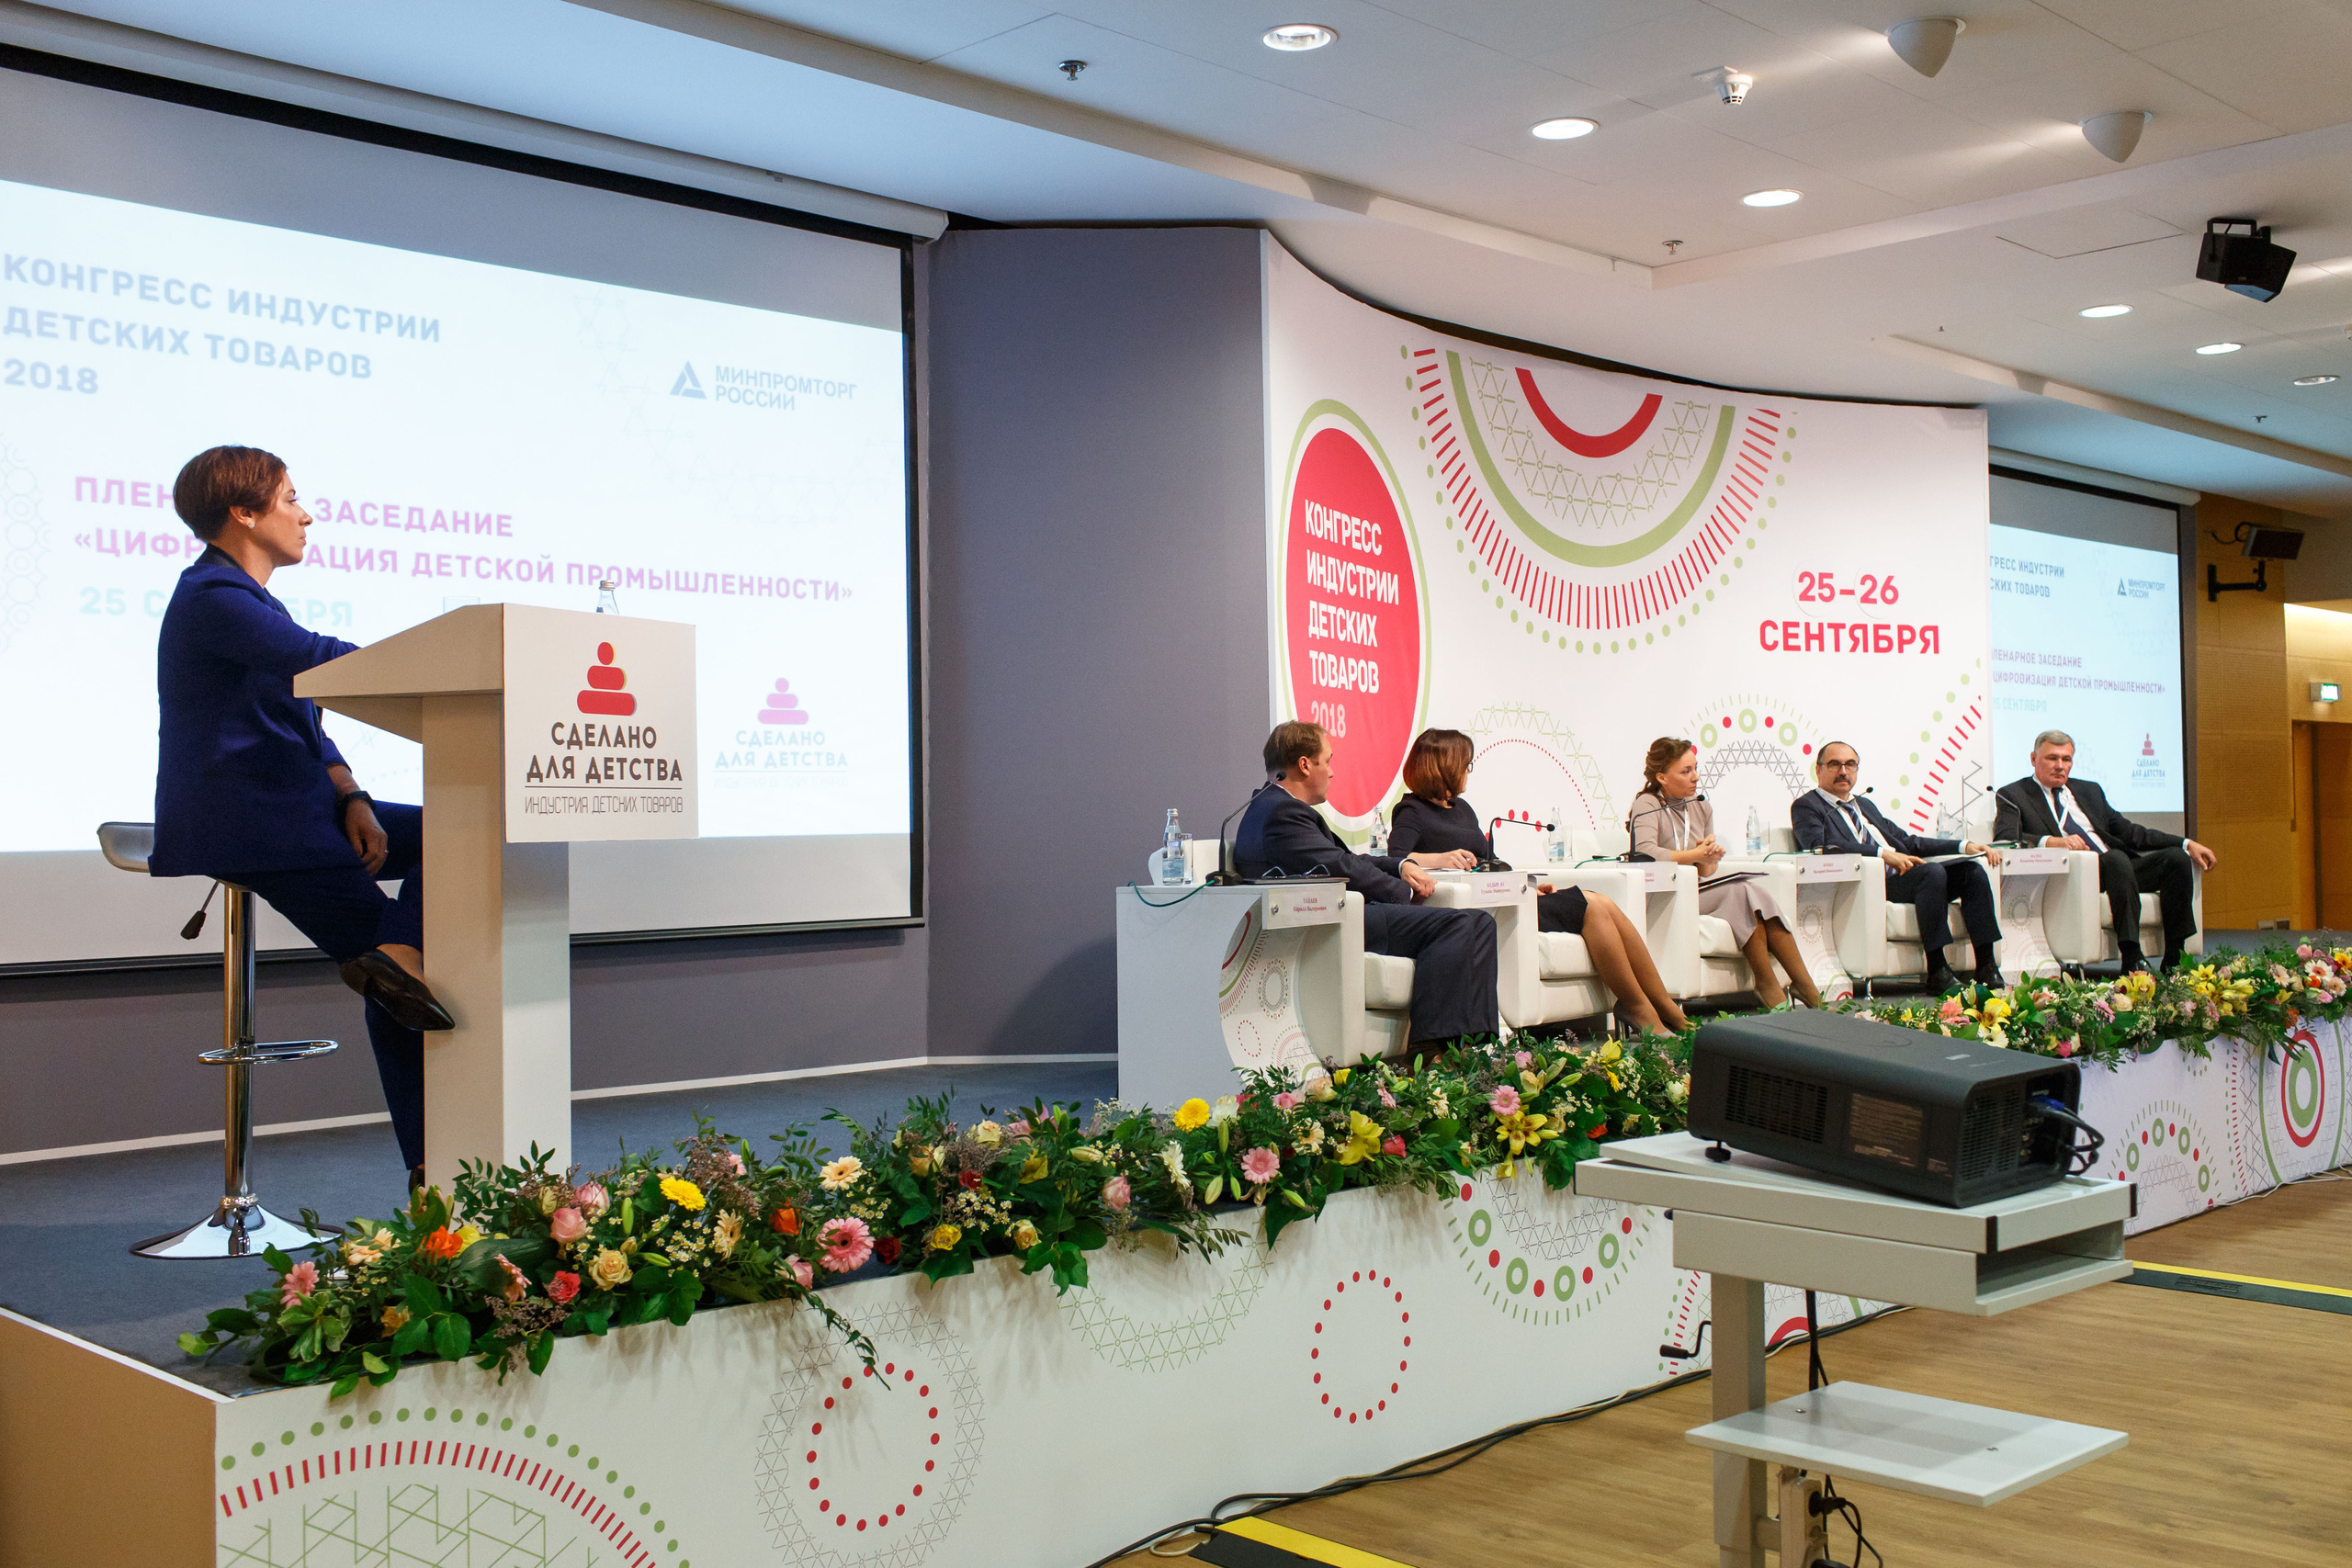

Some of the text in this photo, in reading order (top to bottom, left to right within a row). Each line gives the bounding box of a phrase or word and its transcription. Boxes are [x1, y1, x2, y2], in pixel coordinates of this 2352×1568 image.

[4, 253, 440, 343] КОНГРЕСС ИНДУСТРИИ
[3, 305, 372, 378] ДЕТСКИХ ТОВАРОВ
[4, 358, 98, 395] 2018
[715, 365, 857, 400] МИНПРОМТОРГ
[715, 385, 796, 411] РОССИИ
[314, 497, 514, 537] ЗАСЕДАНИЕ
[1305, 499, 1383, 556] КОНГРЕСС
[411, 552, 555, 584] ДЕТСКОЙ
[566, 561, 852, 602] ПРОМЫШЛЕННОСТИ»
[1306, 548, 1399, 605] ИНДУСТРИИ
[1989, 555, 2065, 578] ГРЕСС ИНДУСТРИИ
[79, 586, 127, 616] 25
[2014, 581, 2051, 598] ТОВАРОВ
[1308, 600, 1378, 648] ДЕТСКИХ
[1759, 619, 1939, 654] СЕНТЯБРЯ
[1308, 649, 1379, 694] ТОВАРОВ
[2038, 653, 2083, 669] ЗАСЕДАНИЕ
[2058, 675, 2092, 690] ДЕТСКОЙ
[550, 721, 657, 750] СДЕЛАНО
[1310, 699, 1347, 739] 2018
[735, 729, 826, 748] СДЕЛАНО
[526, 754, 575, 784] ДЛЯ
[584, 756, 684, 784] ДЕТСТВА
[715, 750, 849, 769] ДЛЯ ДЕТСТВА
[525, 795, 589, 816] ИНДУСТРИЯ
[640, 796, 684, 814] ТОВАРОВ
